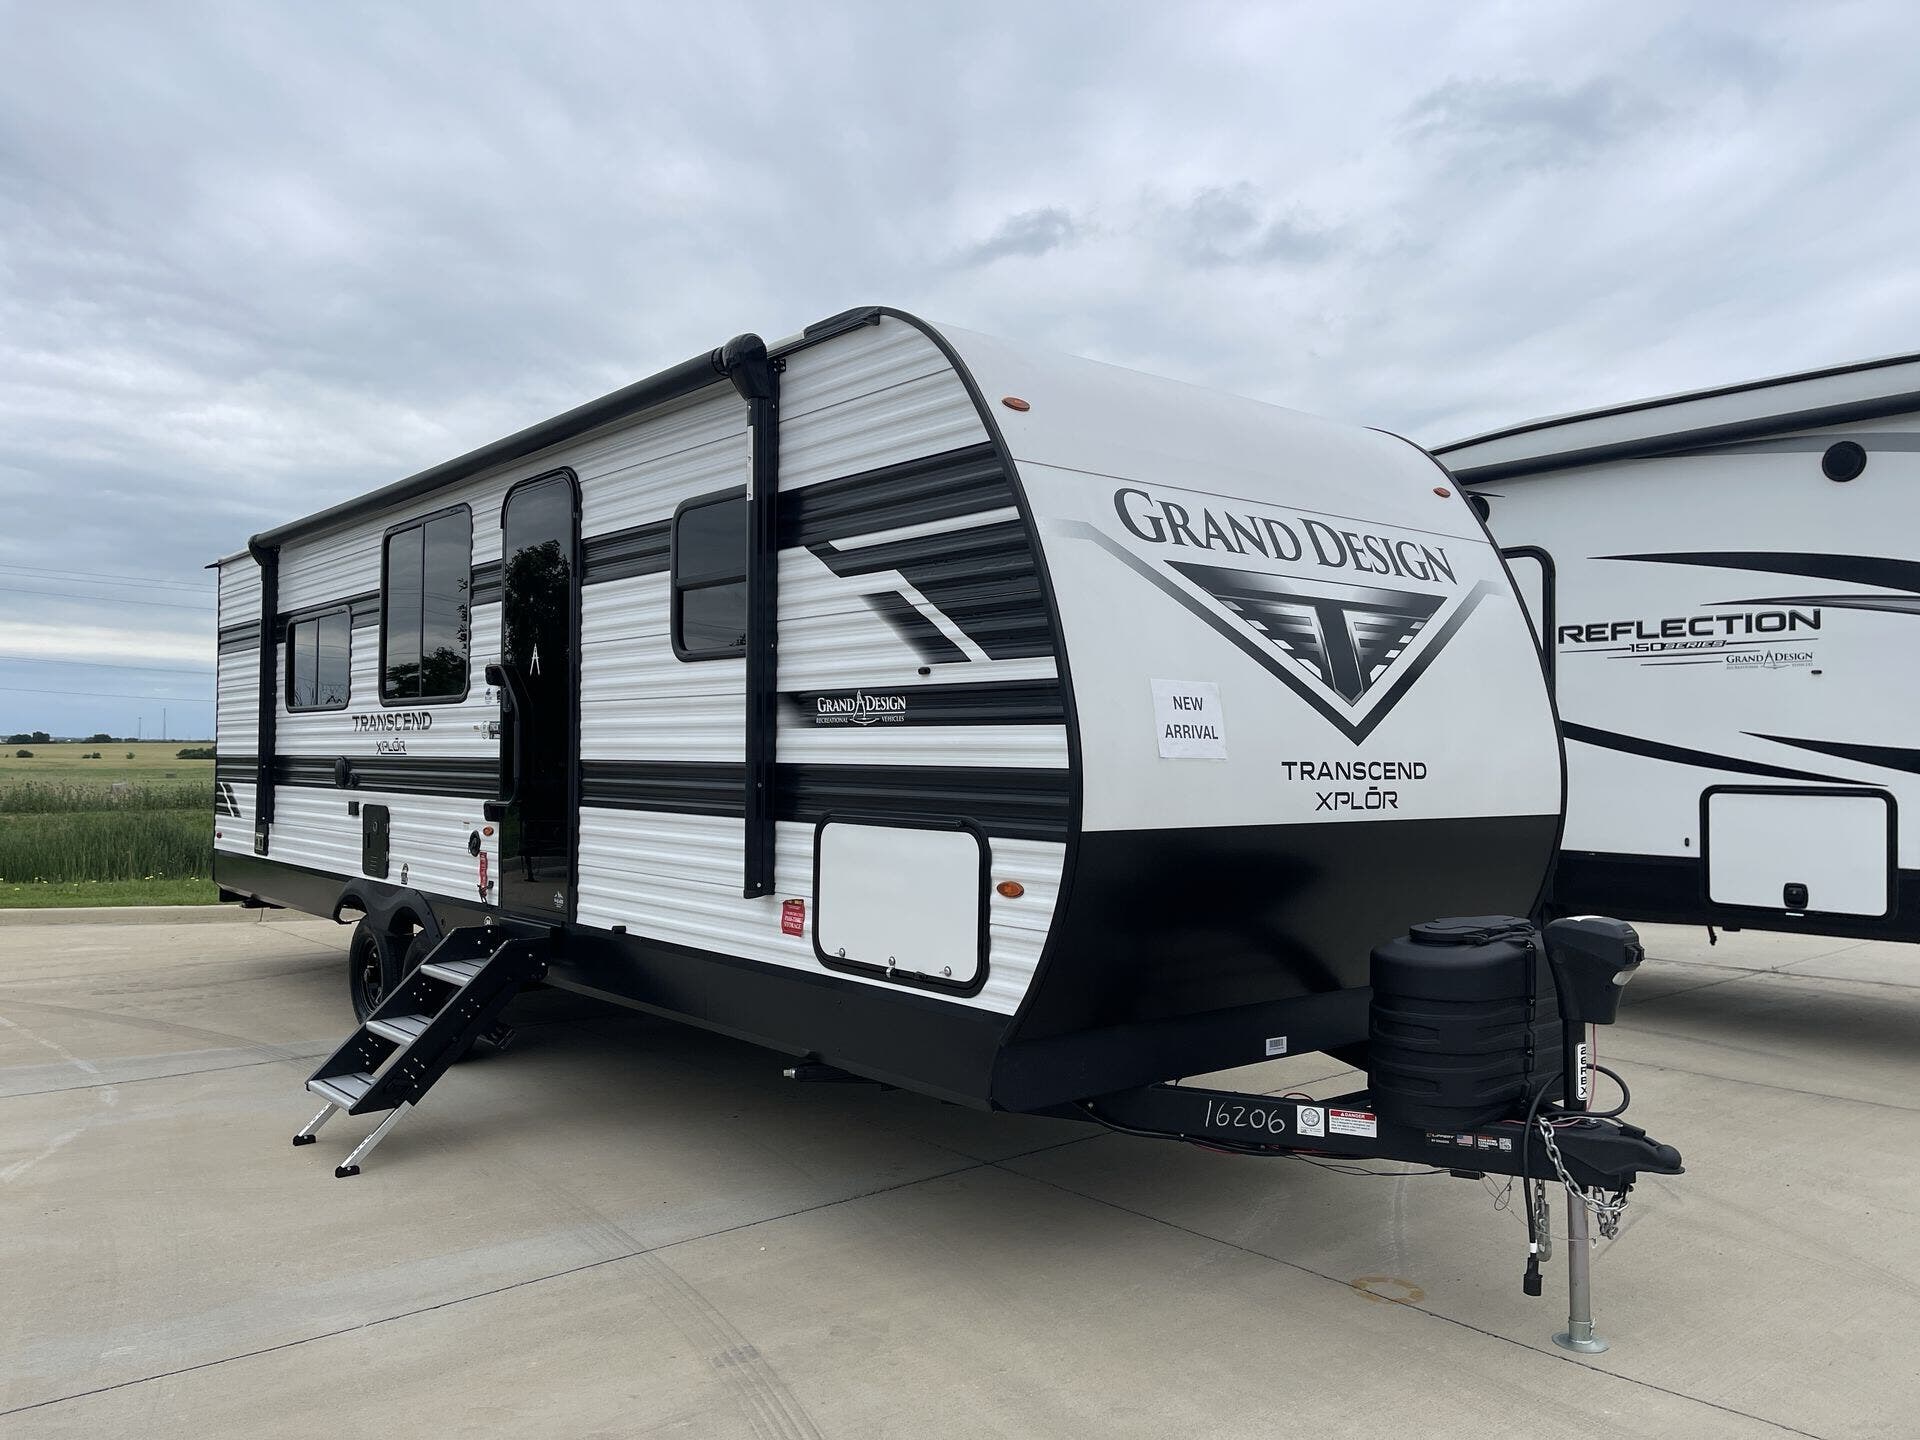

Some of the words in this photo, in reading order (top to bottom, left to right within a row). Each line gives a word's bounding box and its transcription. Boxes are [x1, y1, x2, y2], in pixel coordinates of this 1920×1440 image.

[1113, 487, 1302, 562] GRAND
[1297, 517, 1458, 585] DESIGN
[1558, 609, 1821, 644] REFLECTION
[1726, 654, 1764, 664] GRAND
[1775, 652, 1813, 662] DESIGN
[817, 697, 856, 713] GRAND
[864, 695, 906, 711] DESIGN
[1173, 696, 1203, 711] NEW
[352, 712, 432, 732] TRANSCEND
[1165, 724, 1219, 740] ARRIVAL
[1281, 761, 1427, 780] TRANSCEND
[1205, 1100, 1286, 1134] 16206
